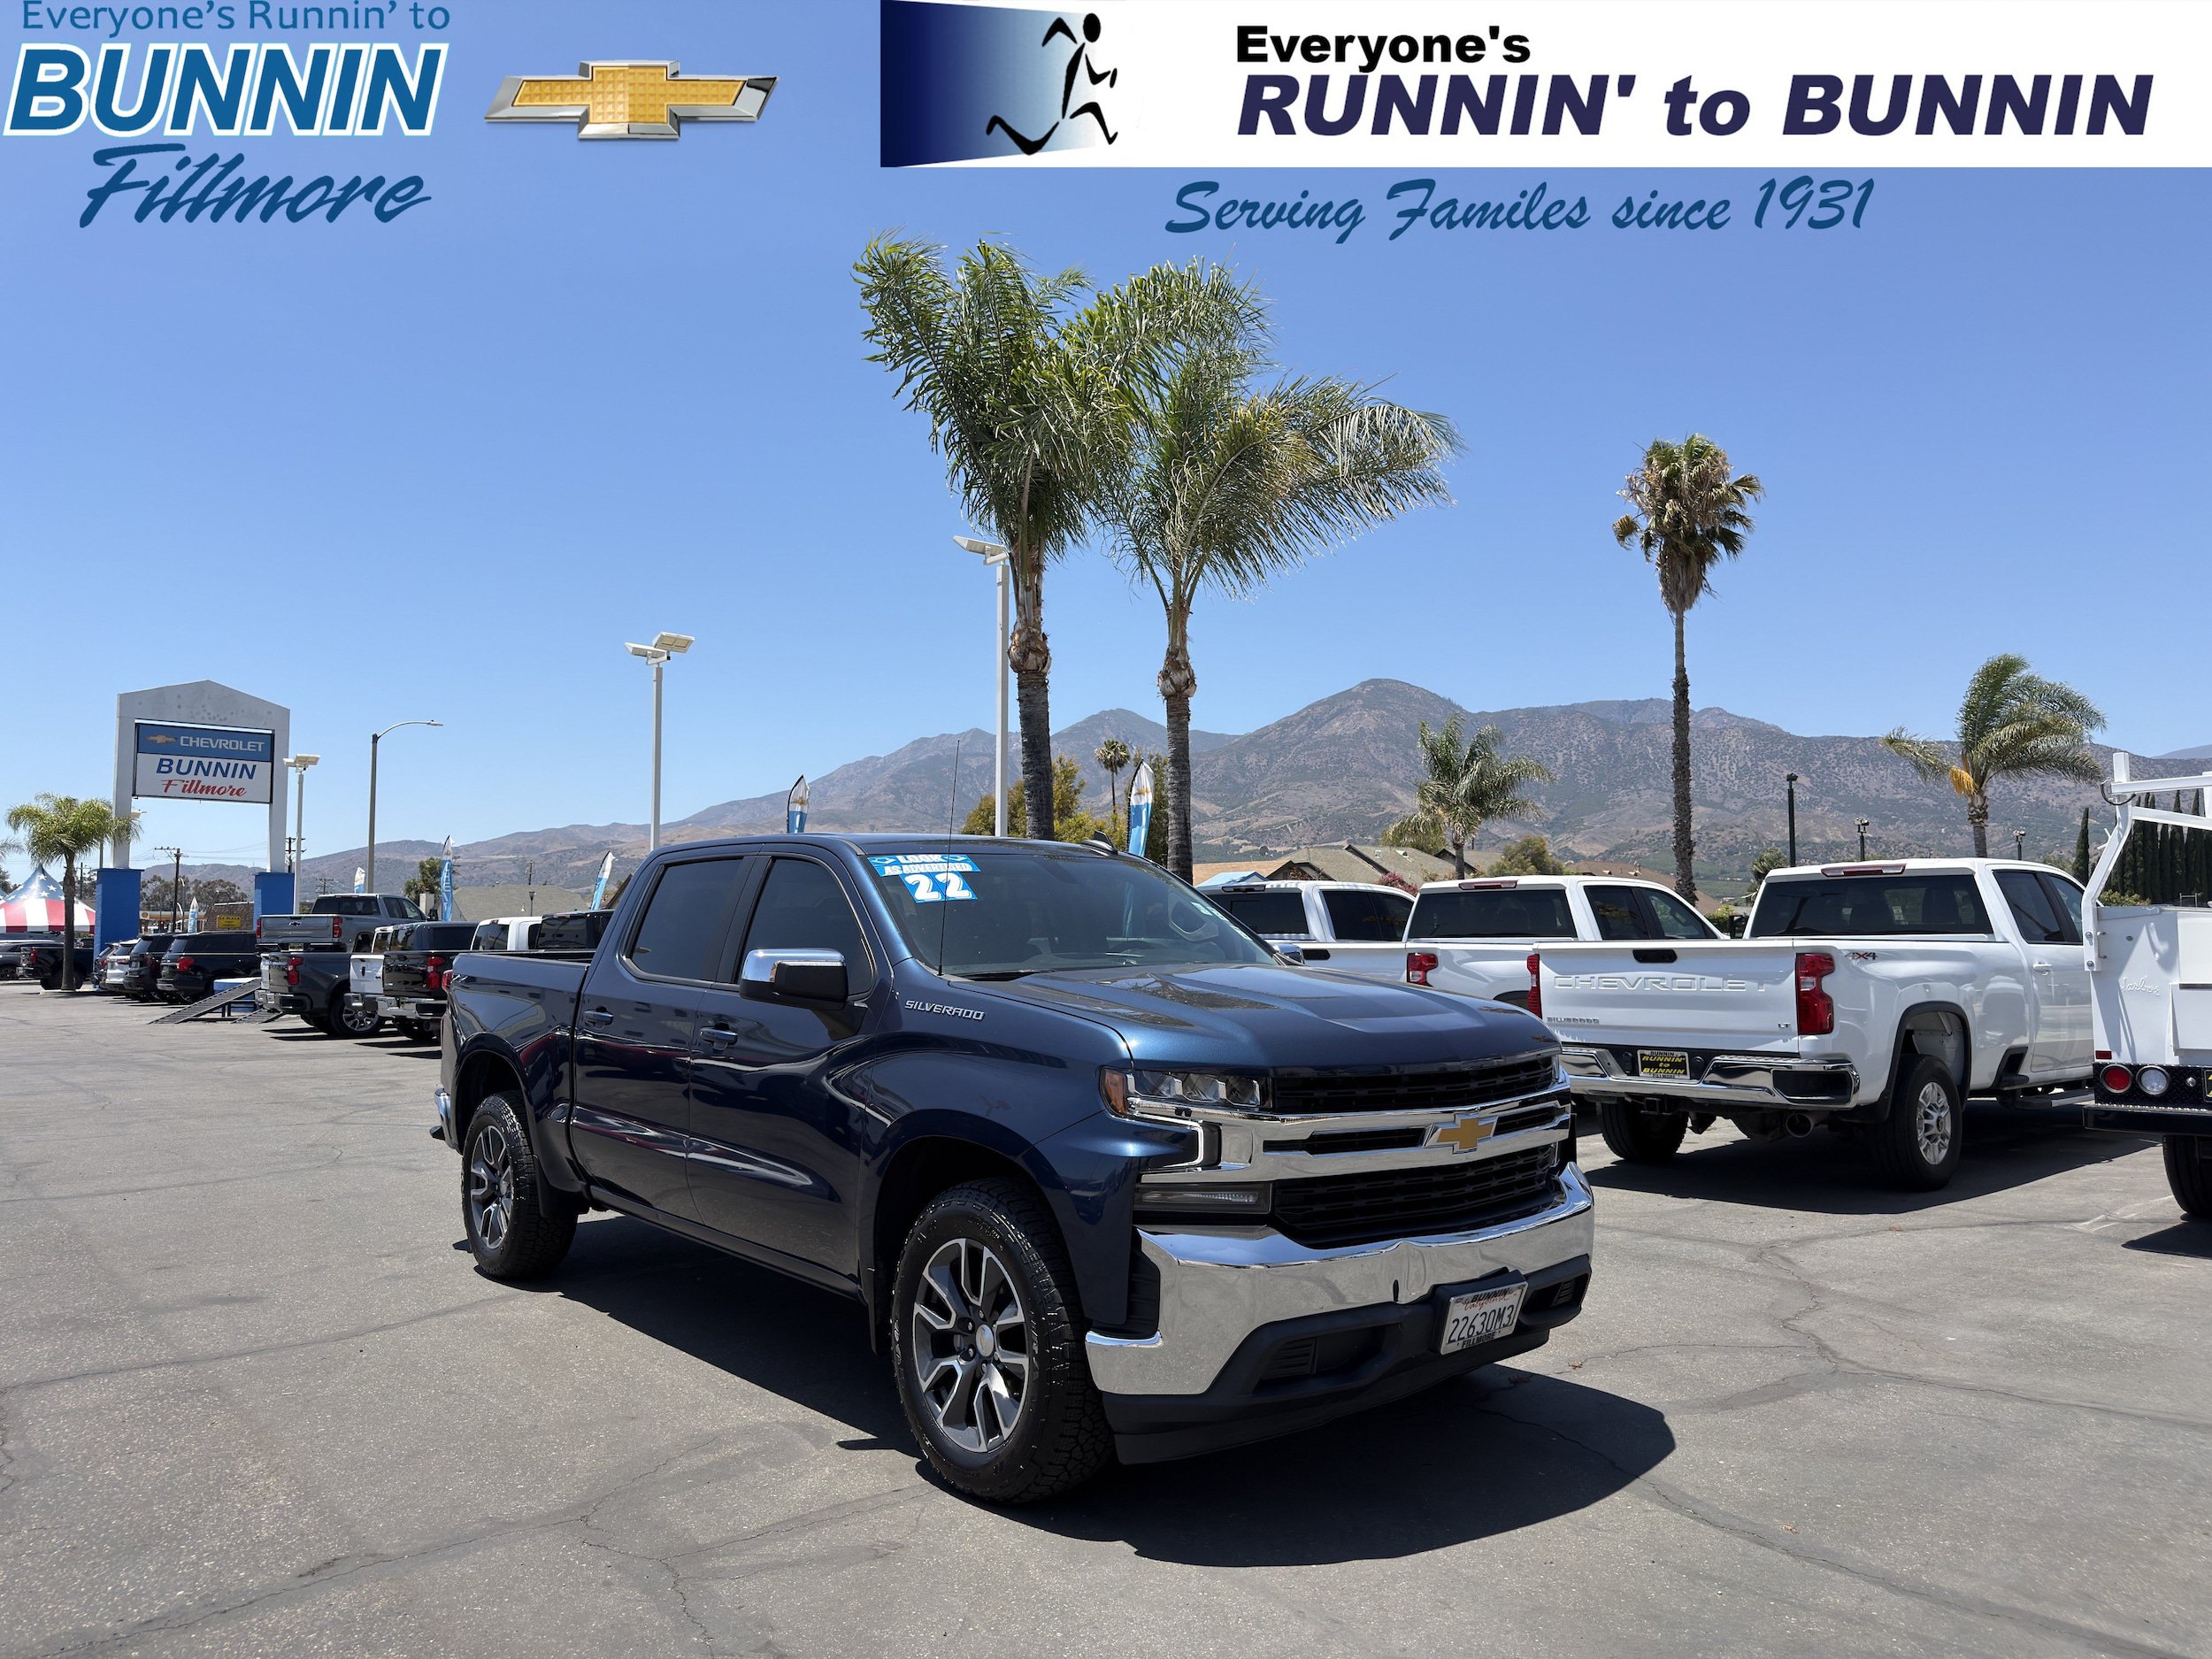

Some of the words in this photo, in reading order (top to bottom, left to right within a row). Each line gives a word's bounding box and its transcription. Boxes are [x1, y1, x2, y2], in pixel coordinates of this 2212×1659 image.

[180, 735, 265, 752] CHEVROLET
[156, 757, 257, 780] BUNNIN
[160, 779, 248, 797] Fillmore
[895, 854, 944, 864] LOOK
[884, 864, 902, 877] AS
[902, 862, 973, 874] ADVERTISED
[903, 872, 972, 901] 22
[1554, 975, 1768, 993] CHEVROLET
[904, 1000, 986, 1021] SILVERADO
[1471, 1287, 1512, 1302] BUNNIN
[1448, 1304, 1515, 1344] 22630M3
[1462, 1331, 1496, 1349] FILLMORE
